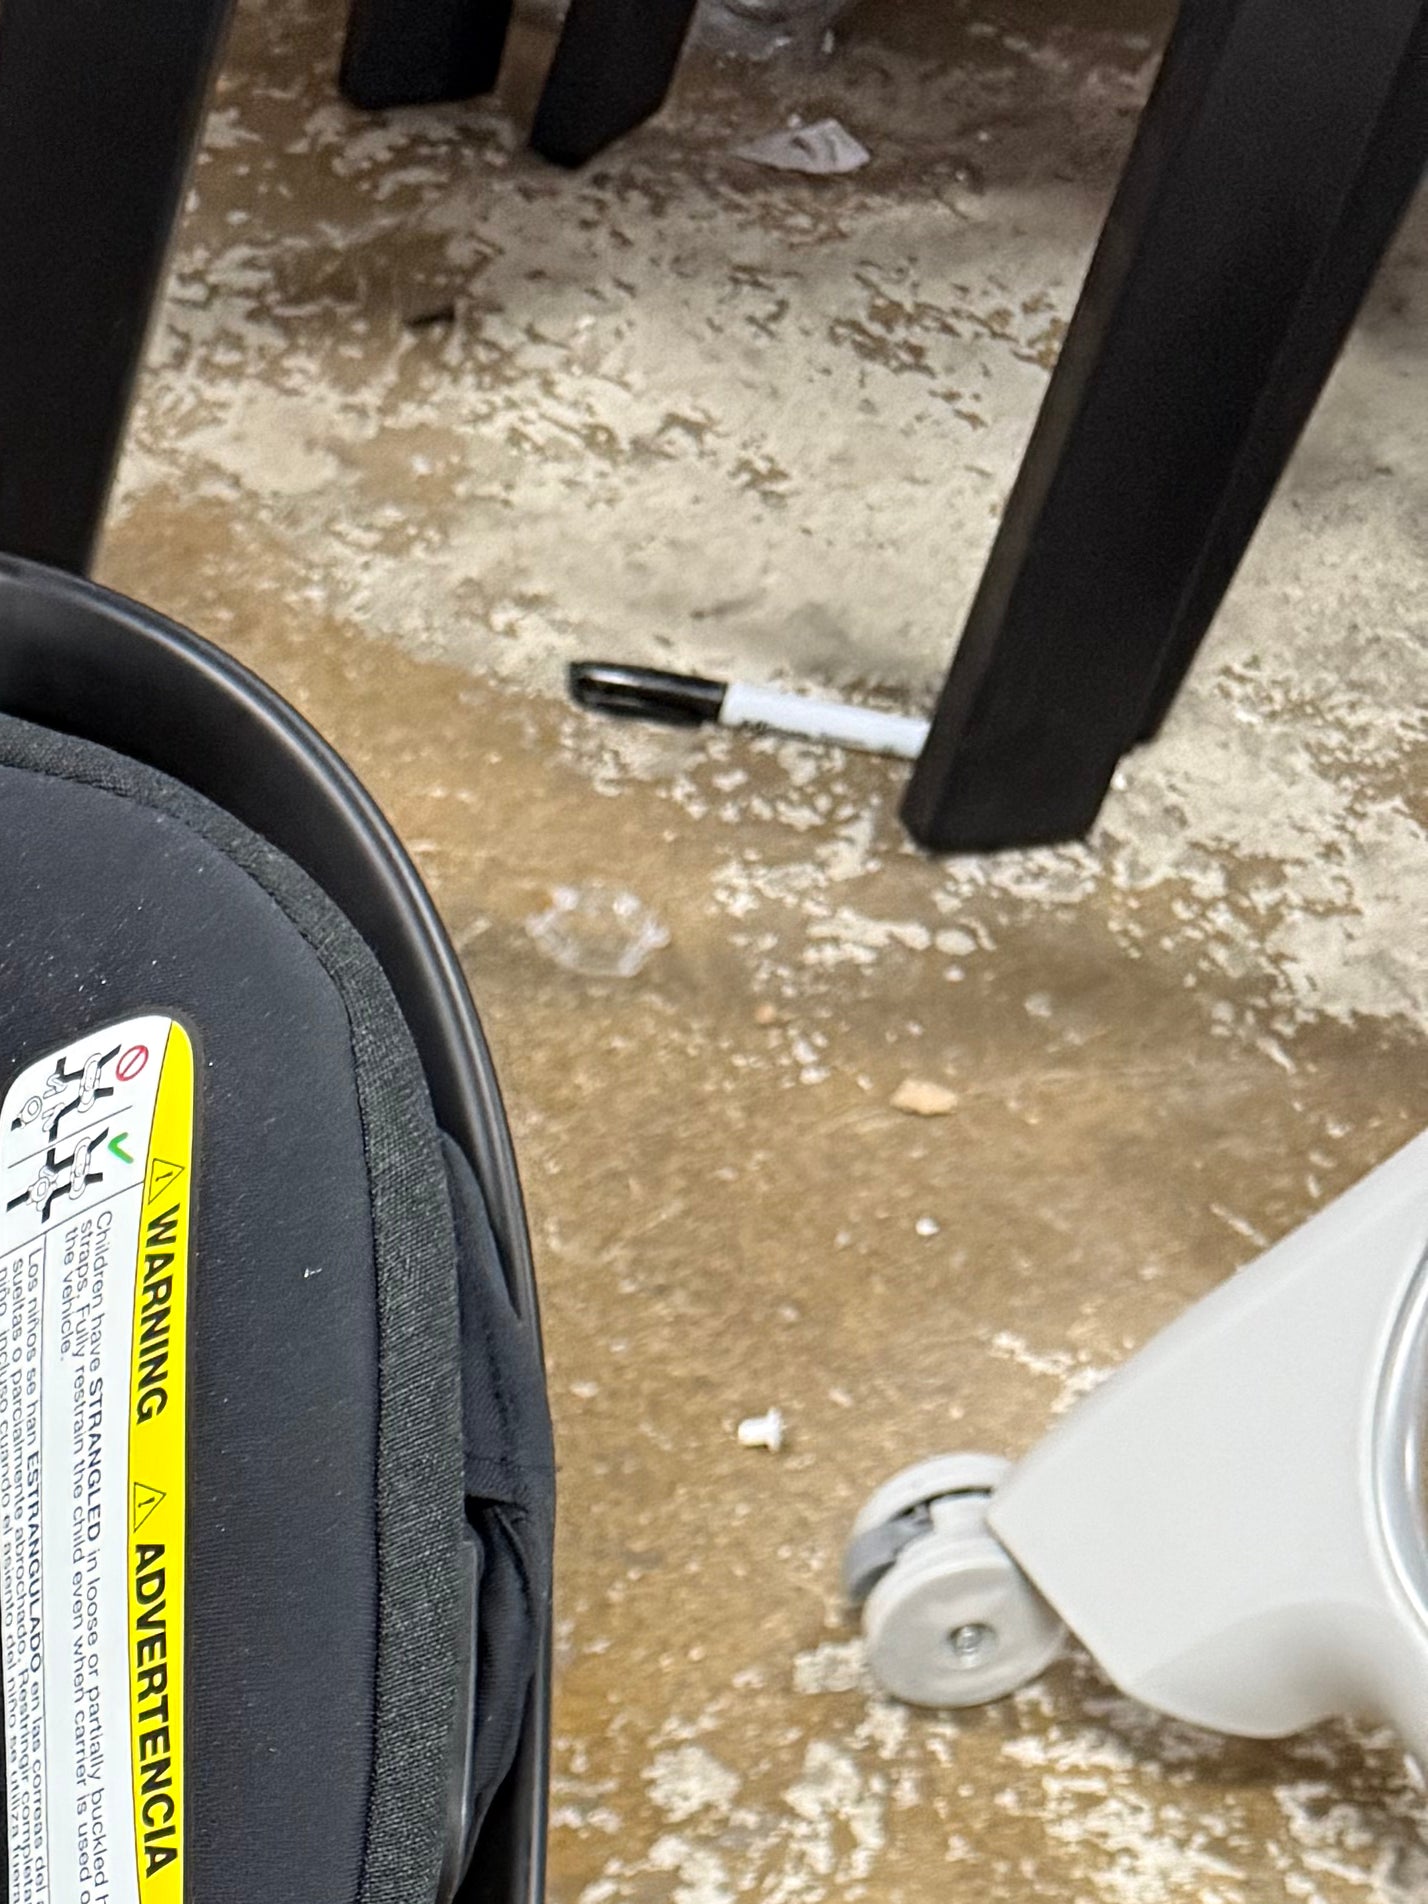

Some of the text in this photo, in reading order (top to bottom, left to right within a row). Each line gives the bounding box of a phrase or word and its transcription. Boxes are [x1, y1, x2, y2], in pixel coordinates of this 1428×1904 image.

[60, 1228, 79, 1360] the vehicle.
[91, 1210, 113, 1309] Children
[71, 1302, 90, 1357] Fully
[88, 1312, 105, 1372] have
[136, 1203, 180, 1425] WARNING
[73, 1364, 86, 1455] restrain
[72, 1458, 86, 1499] the
[86, 1376, 103, 1542] STRANGLED
[72, 1505, 86, 1564] child
[86, 1547, 100, 1573] in
[71, 1570, 83, 1630] even
[86, 1576, 100, 1646] loose
[72, 1634, 90, 1703] when
[87, 1652, 99, 1676] or
[83, 1684, 104, 1779] partially
[134, 1543, 178, 1878] ADVERTENCIA
[74, 1709, 87, 1786] carrier
[75, 1792, 90, 1815] is
[90, 1786, 109, 1887] buckled
[77, 1821, 92, 1882] used
